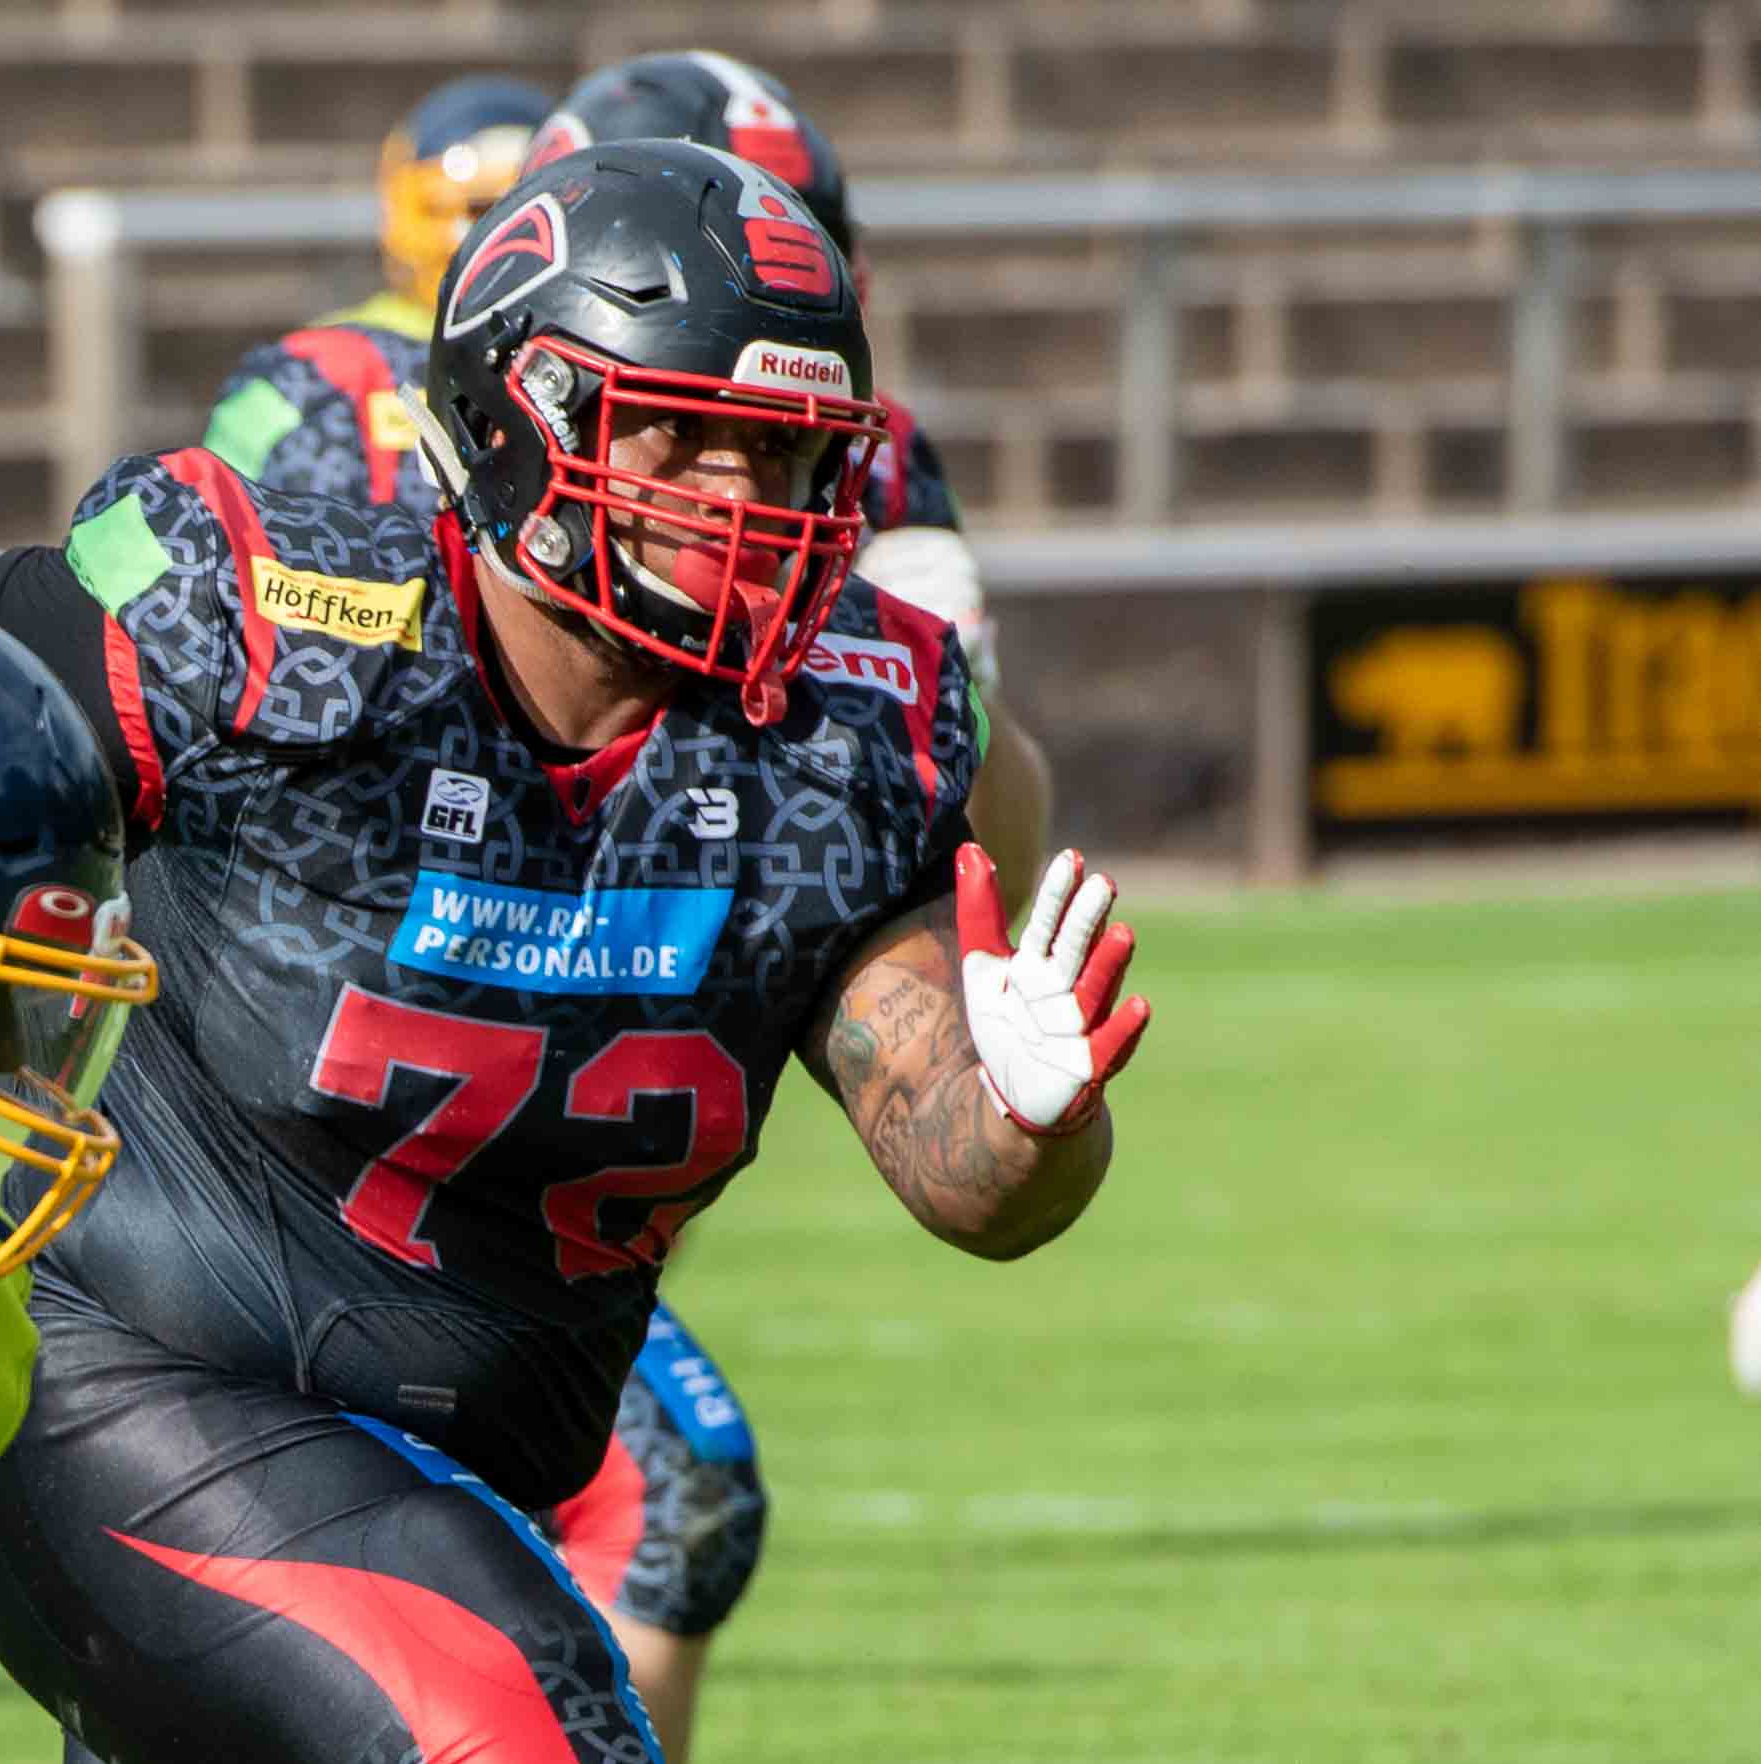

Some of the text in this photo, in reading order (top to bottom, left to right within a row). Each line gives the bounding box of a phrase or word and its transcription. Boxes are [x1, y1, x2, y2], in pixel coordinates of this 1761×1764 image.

[760, 352, 845, 386] Riddell
[805, 645, 912, 692] em
[428, 804, 477, 837] GFL
[431, 886, 610, 938] WWW.RH-
[413, 925, 679, 979] PERSONAL.DE
[310, 981, 747, 1280] 72
